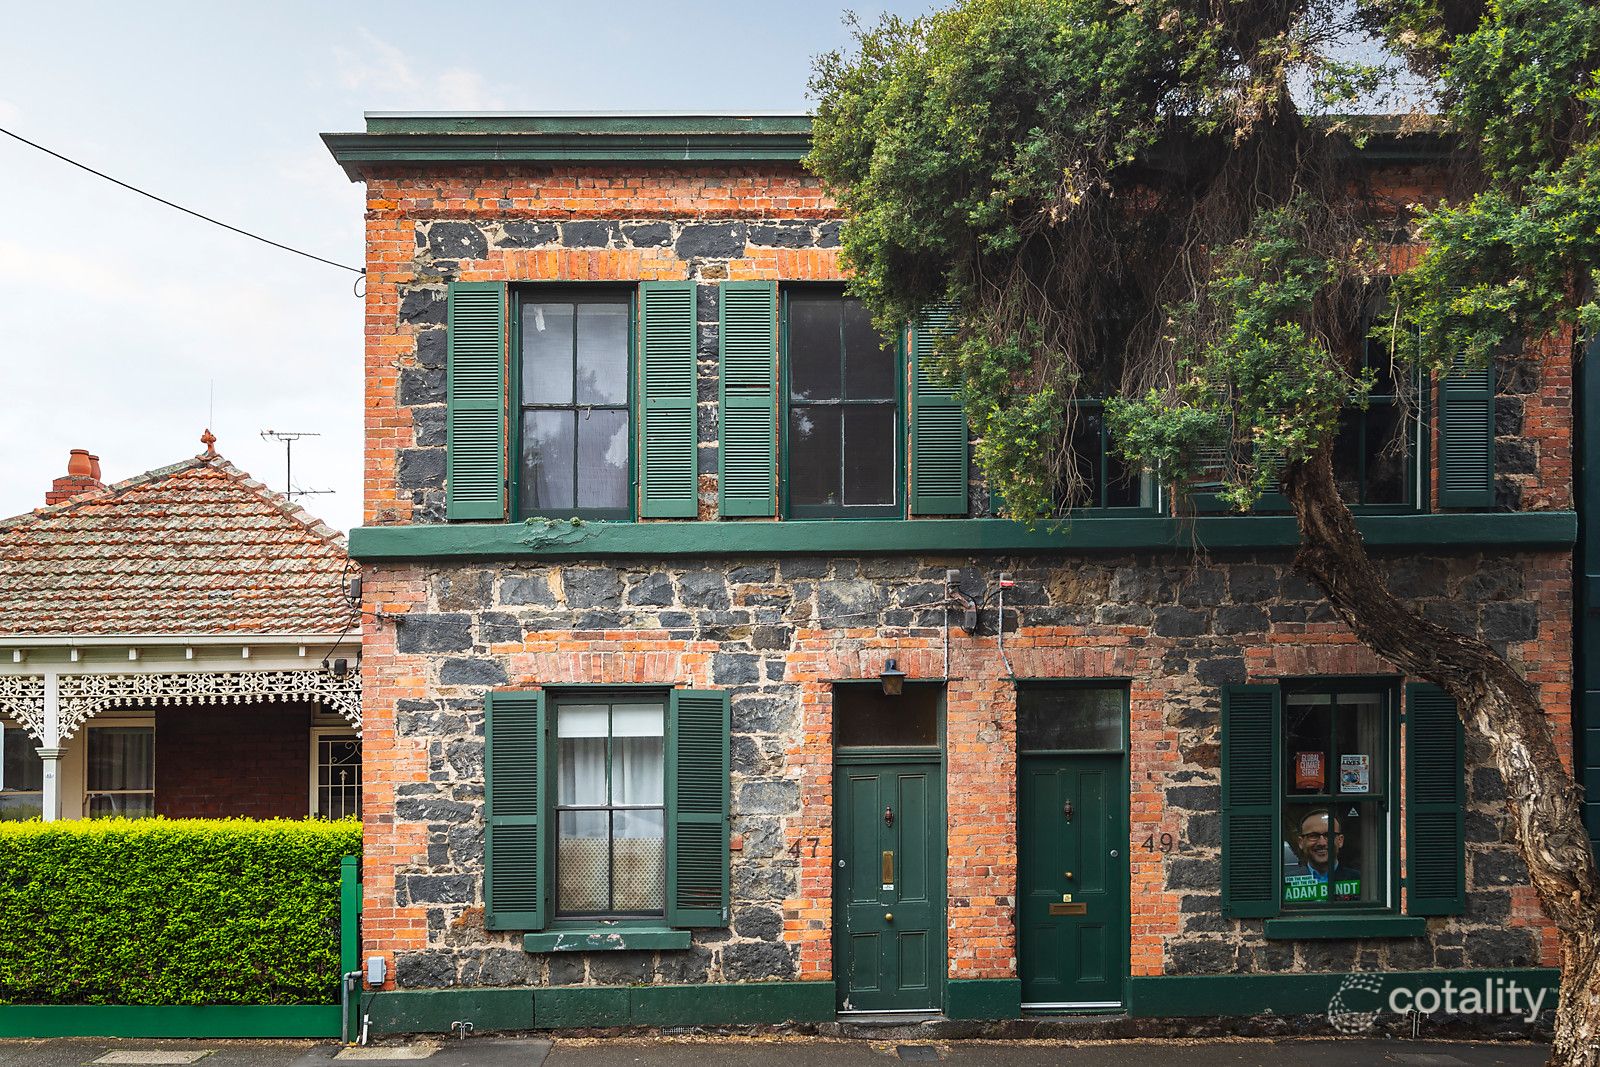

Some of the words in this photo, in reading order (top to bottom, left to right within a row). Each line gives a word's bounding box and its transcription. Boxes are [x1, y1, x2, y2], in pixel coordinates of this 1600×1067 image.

[1301, 754, 1319, 762] GLOBAL
[1300, 761, 1320, 769] CLIMATE
[1301, 769, 1319, 777] STRIKE
[788, 838, 820, 858] 47
[1141, 833, 1173, 853] 49
[1285, 885, 1317, 900] ADAM
[1321, 882, 1358, 897] BNDT
